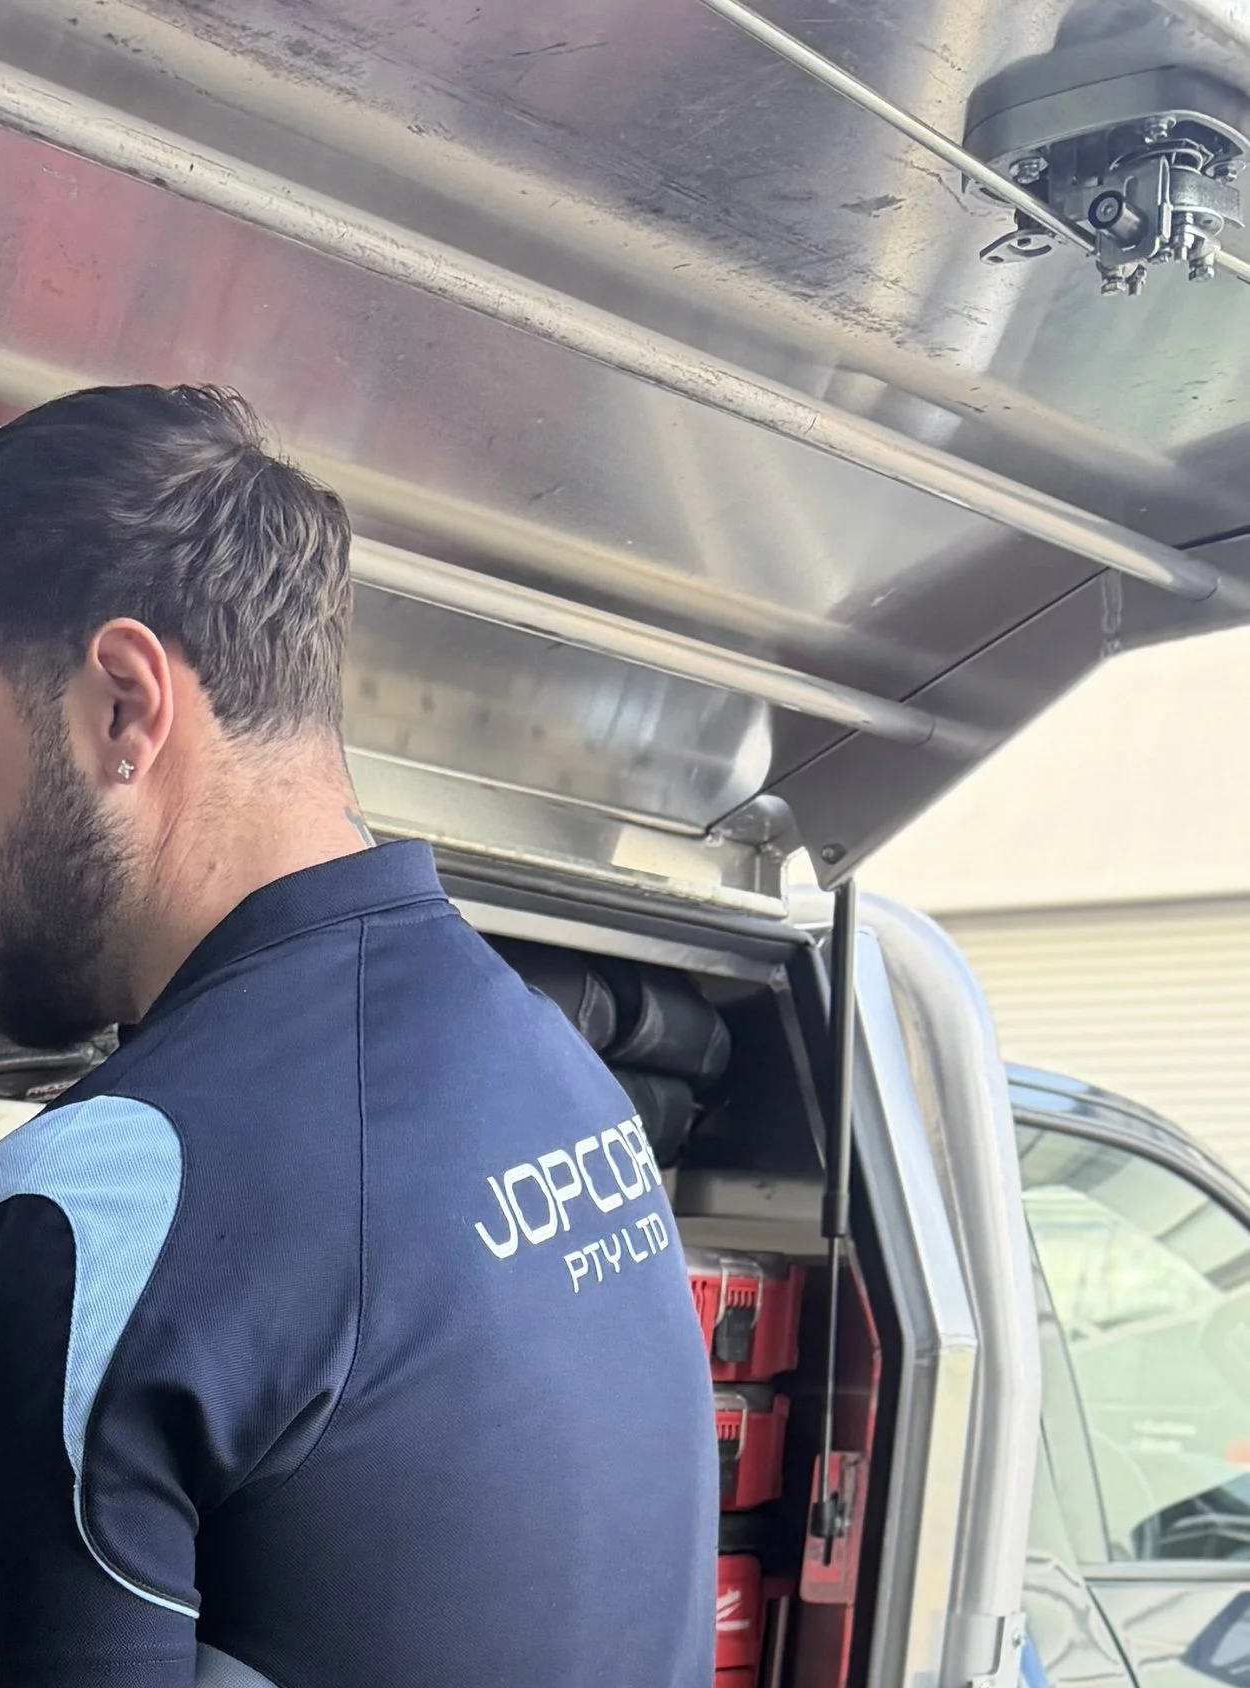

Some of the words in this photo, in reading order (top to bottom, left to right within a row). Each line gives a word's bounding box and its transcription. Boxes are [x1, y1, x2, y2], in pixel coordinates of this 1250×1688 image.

[474, 1114, 662, 1259] JOPCOR
[563, 1236, 622, 1294] PTY
[621, 1212, 669, 1263] LTD
